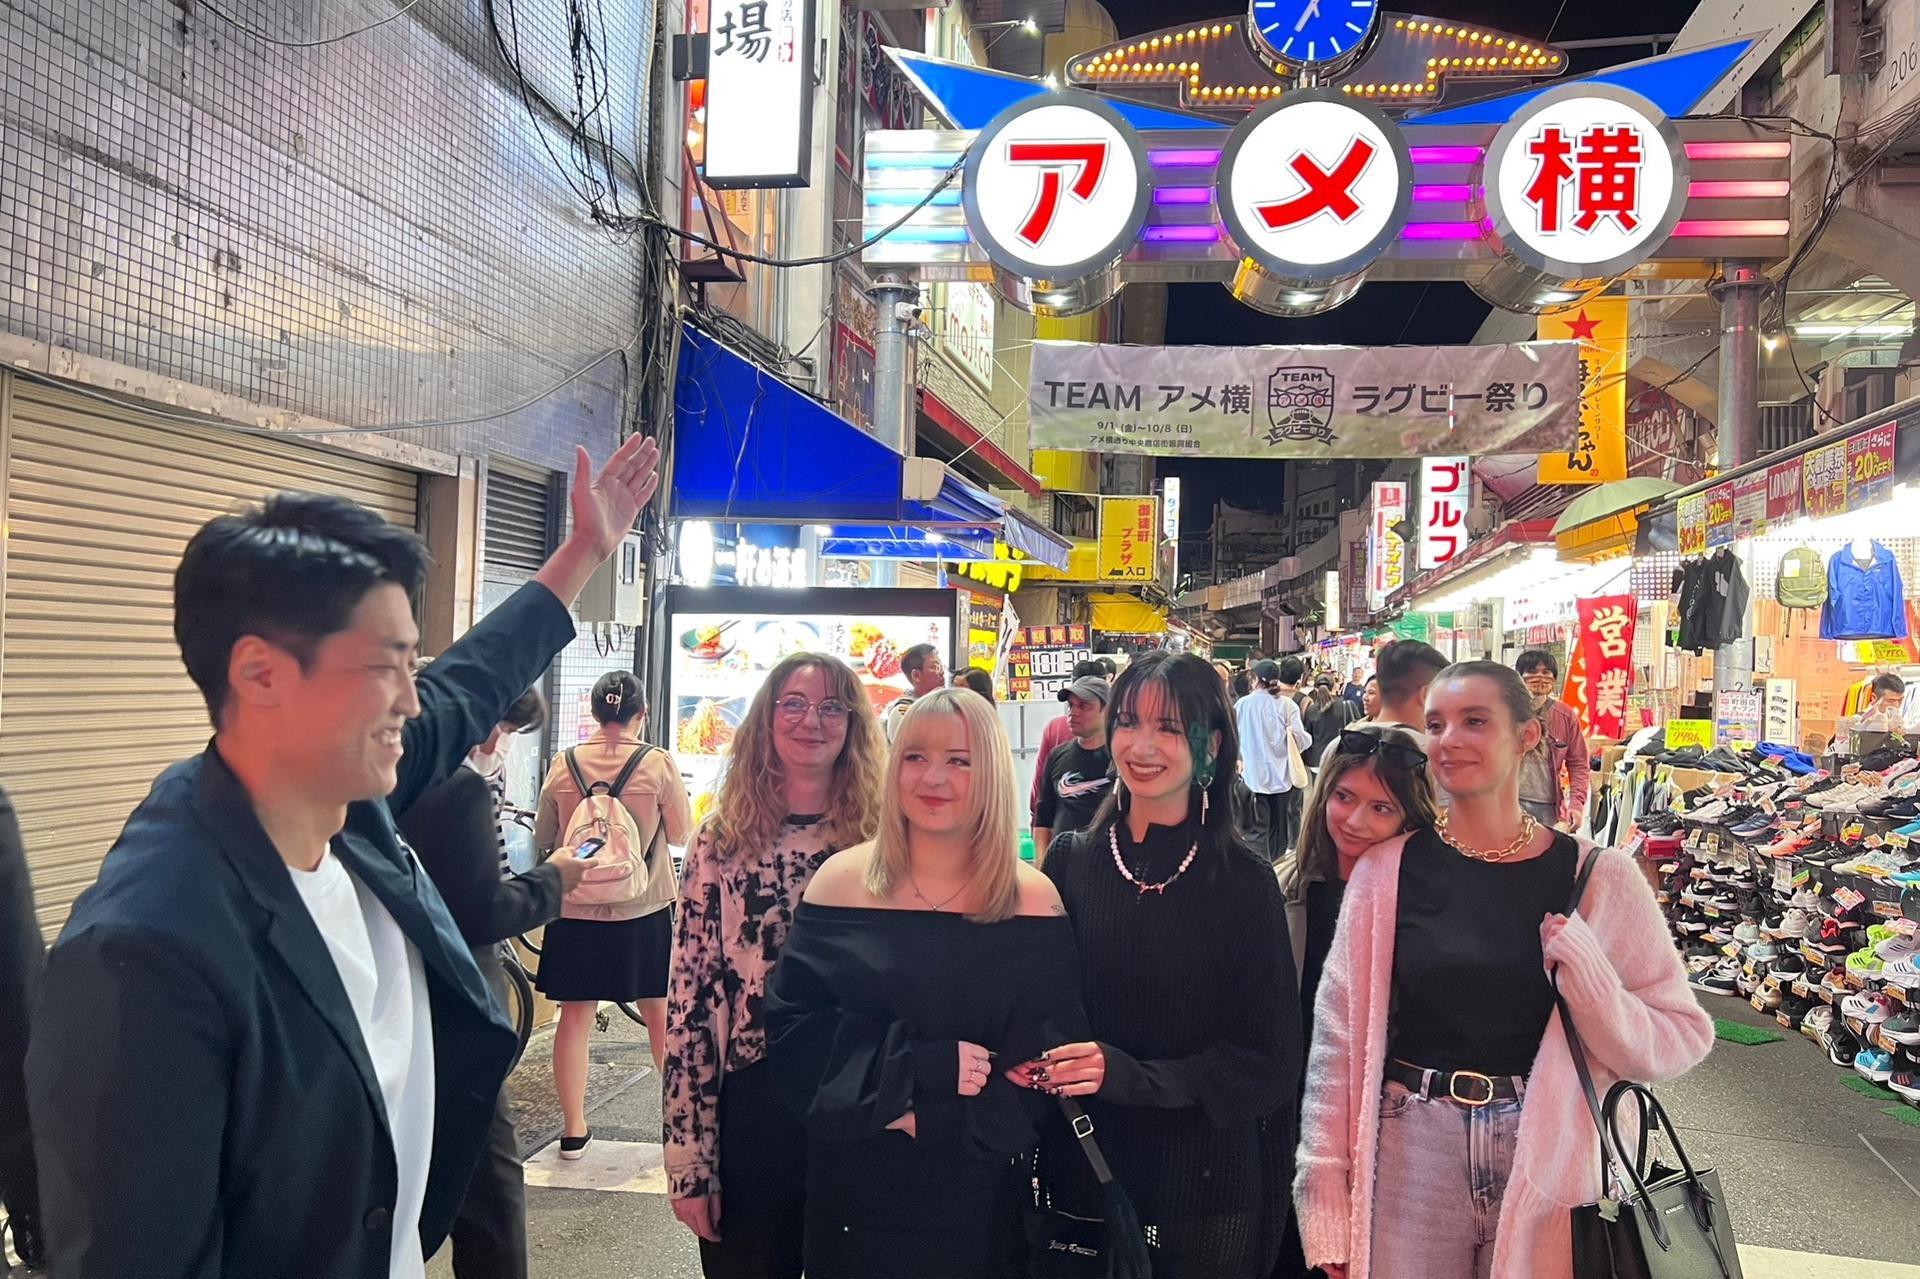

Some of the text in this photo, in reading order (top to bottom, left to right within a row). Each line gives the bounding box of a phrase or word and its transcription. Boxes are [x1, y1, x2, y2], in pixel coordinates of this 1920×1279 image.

[714, 1, 772, 63] 場
[1889, 42, 1918, 91] 206
[1044, 380, 1252, 414] TEAM アメ横
[1281, 373, 1322, 381] TEAM
[1352, 382, 1549, 414] ラグビー祭り
[1429, 462, 1465, 563] ゴルフ
[1125, 566, 1146, 576] 入口
[1589, 605, 1631, 739] 営業
